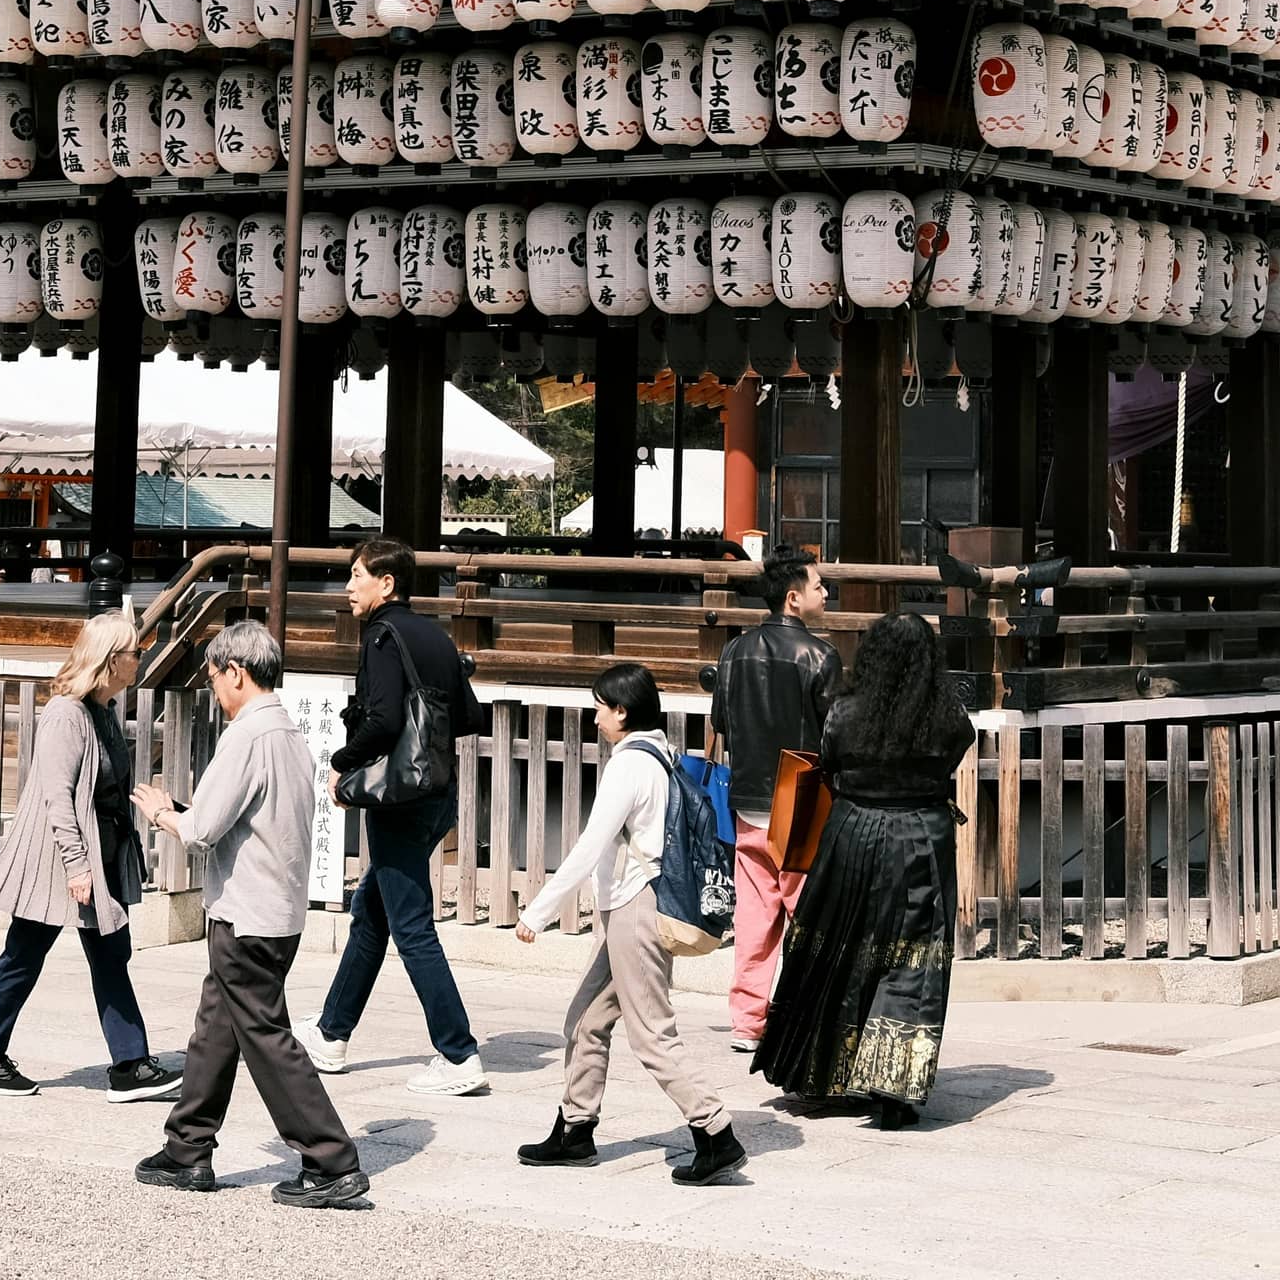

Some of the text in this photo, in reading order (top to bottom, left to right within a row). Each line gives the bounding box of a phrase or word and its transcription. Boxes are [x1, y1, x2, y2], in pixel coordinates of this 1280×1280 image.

[64, 86, 76, 123] 株式会社
[165, 77, 192, 168] みの家
[398, 58, 425, 150] 田崎真也
[708, 34, 735, 134] こじま屋
[61, 126, 85, 173] 天塩
[1187, 92, 1204, 170] Wands
[64, 233, 75, 265] 株式会社
[139, 227, 166, 317] 小松陽一郎
[402, 212, 425, 310] 北村クリニック
[592, 210, 617, 308] 演算工房
[718, 232, 743, 298] カオス
[777, 219, 794, 300] KAORU
